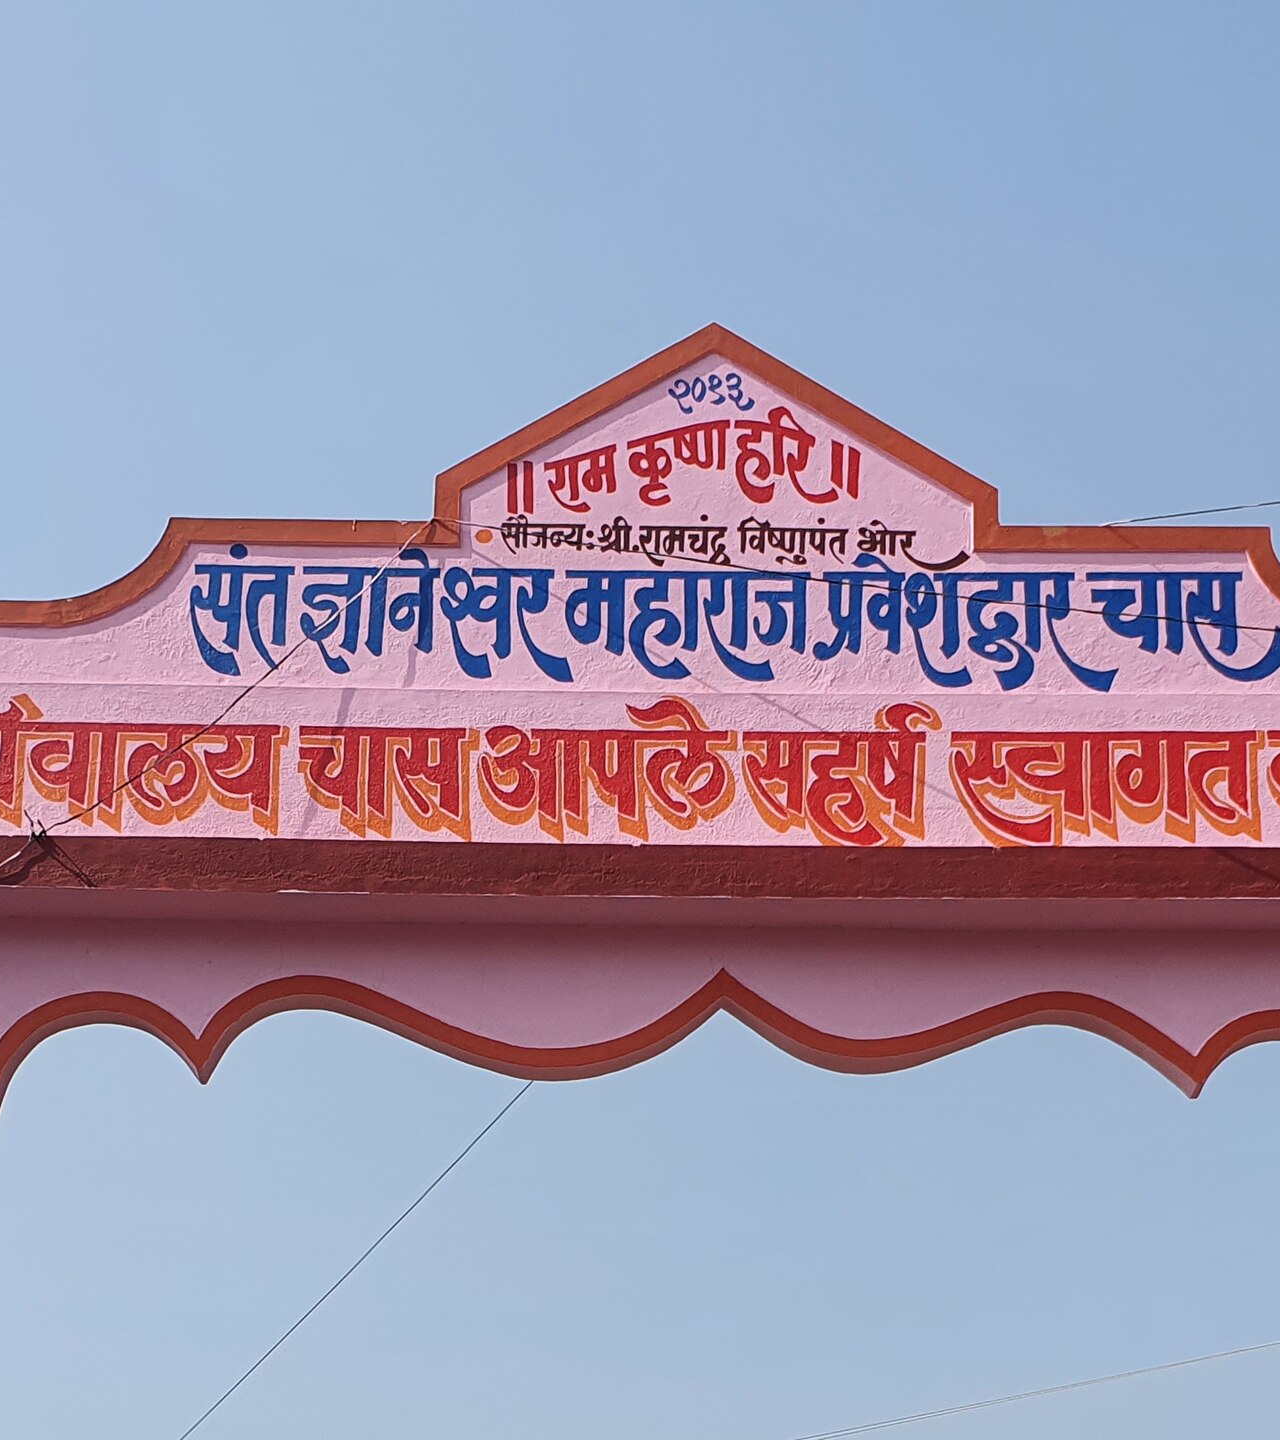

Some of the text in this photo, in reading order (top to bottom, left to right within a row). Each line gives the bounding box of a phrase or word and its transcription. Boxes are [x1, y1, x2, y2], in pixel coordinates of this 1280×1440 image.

[668, 373, 755, 414] २०१३
[543, 444, 618, 513] राम
[626, 419, 731, 506] कृष्ण
[734, 406, 839, 504] हरि
[736, 516, 850, 565] विष्णुपंत
[856, 519, 971, 571] भोर
[189, 543, 296, 677] संत
[299, 549, 574, 683] ज्ञानेश्वर
[564, 568, 812, 682] महाराज
[813, 553, 1120, 693] प्रवेशद्वार
[297, 725, 480, 841] चास
[477, 696, 740, 843] आपले
[738, 701, 942, 847] सहर्ष
[949, 728, 1266, 849] स्वागत
